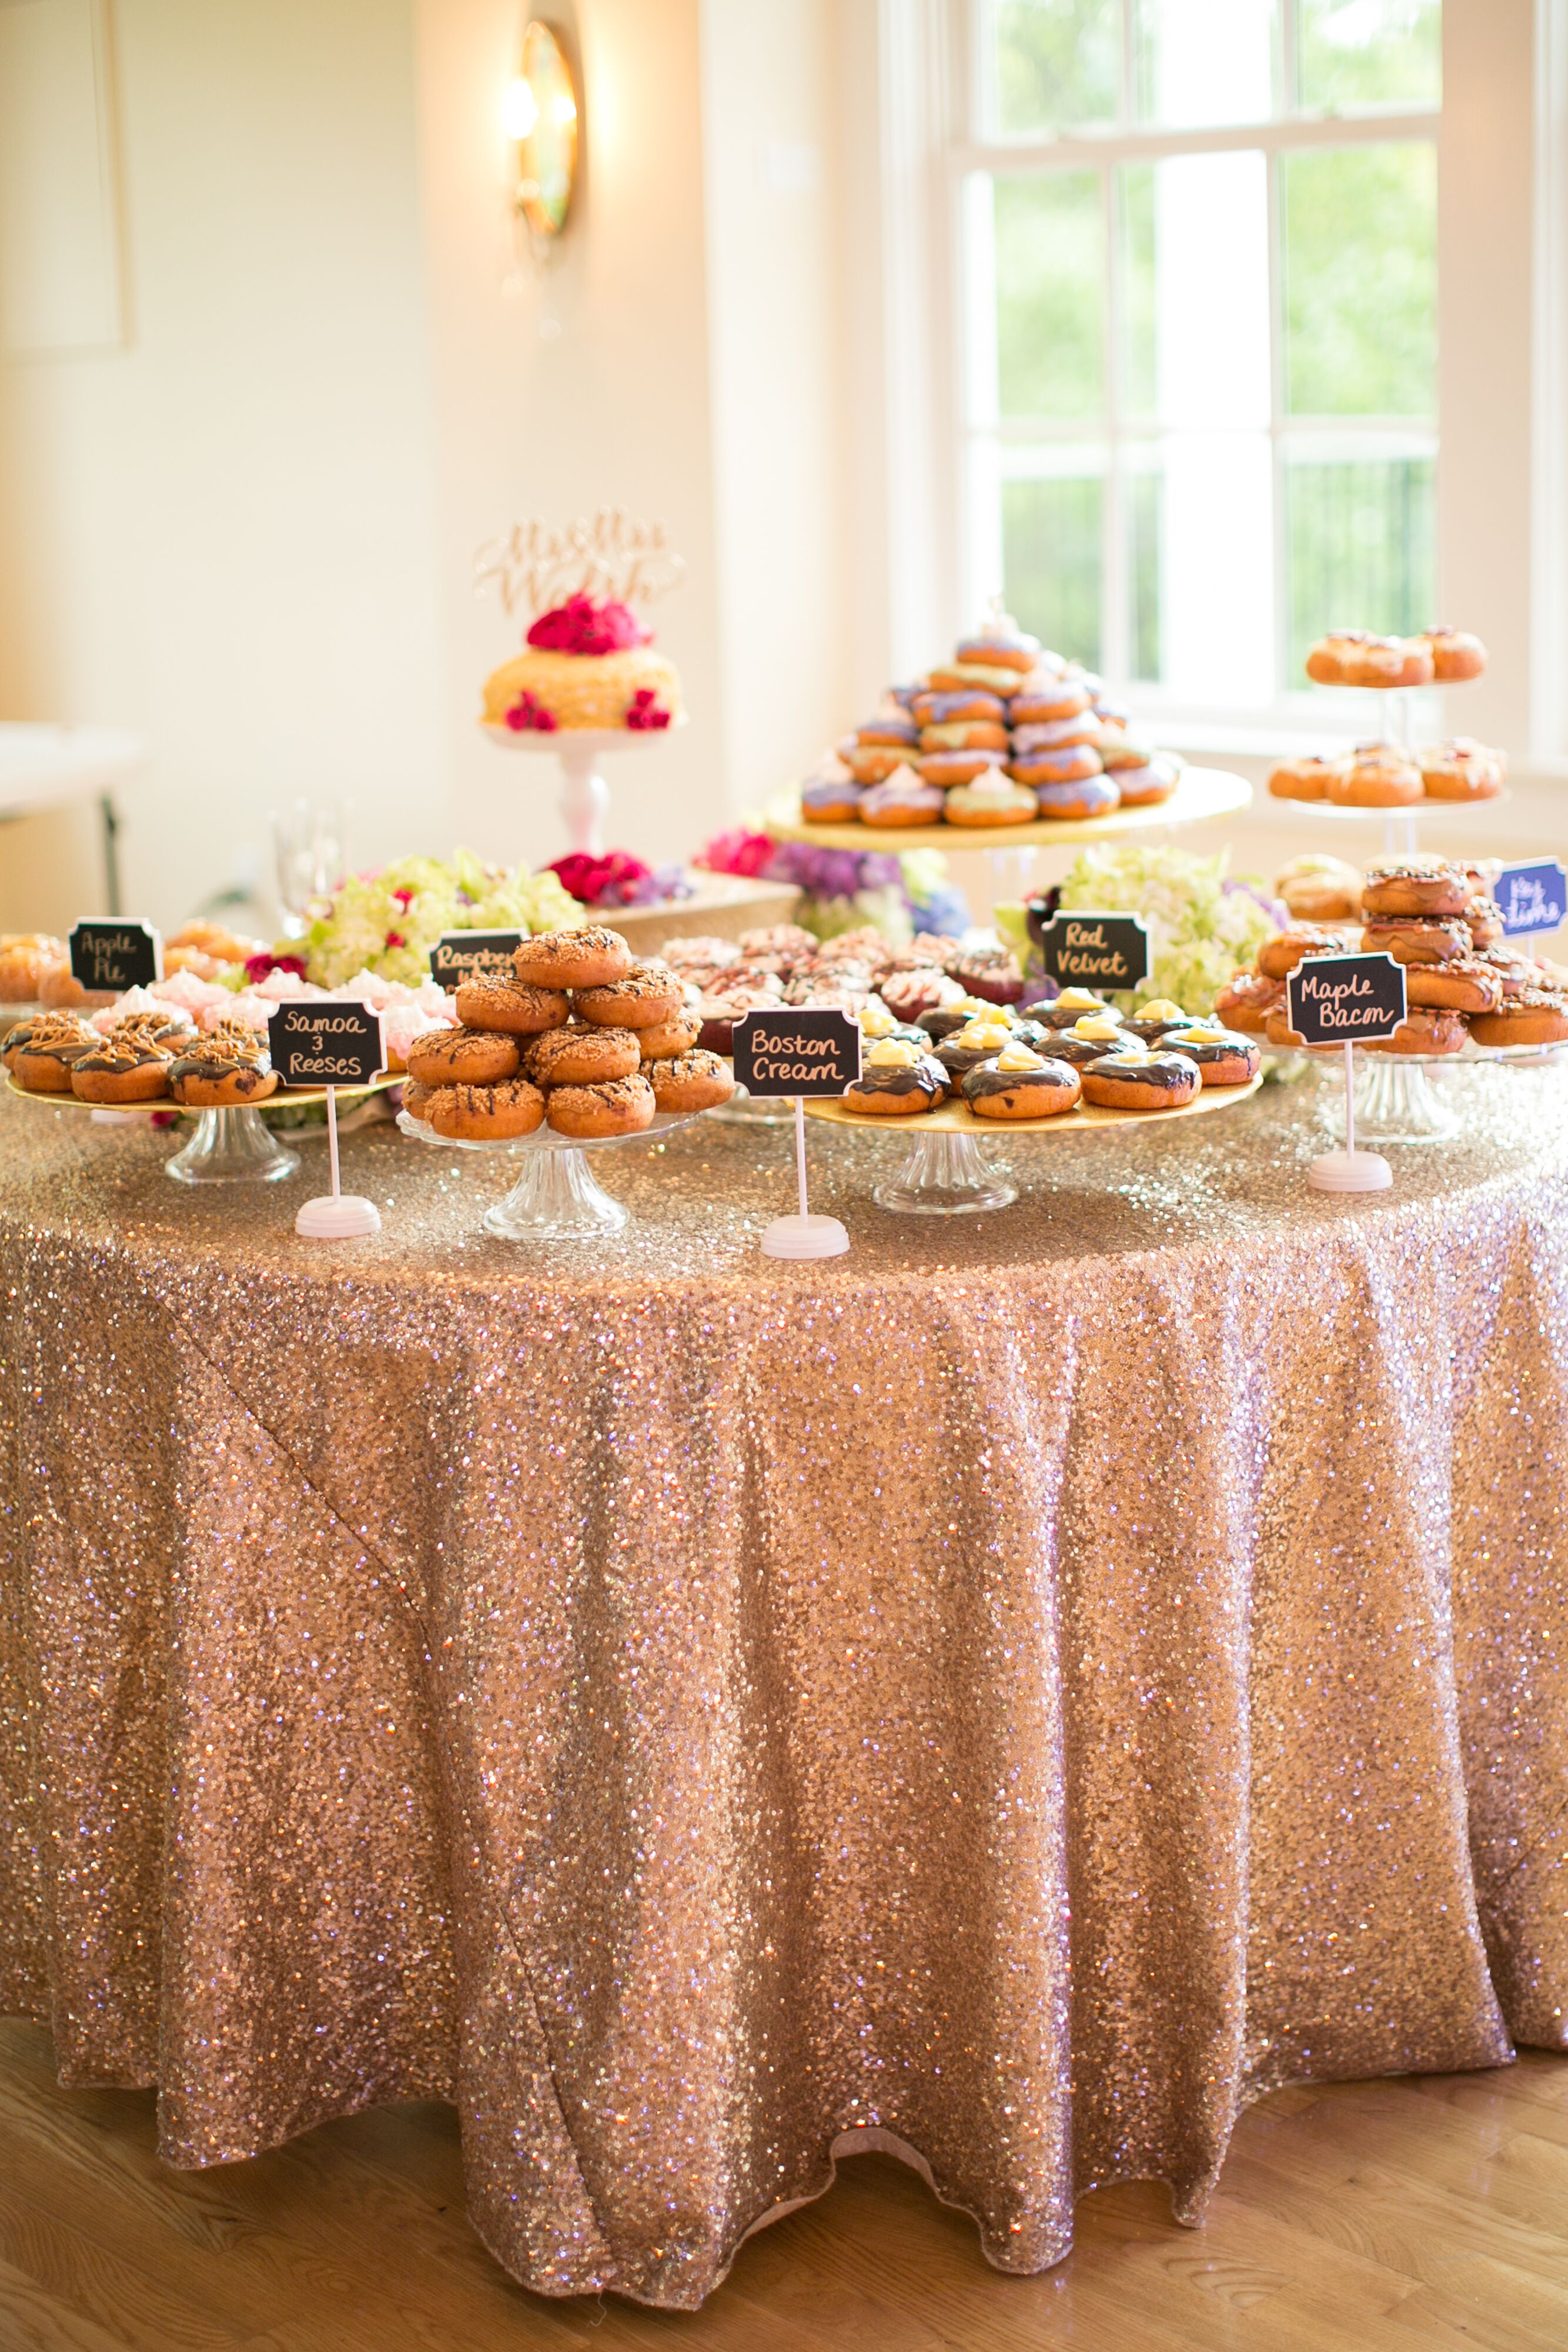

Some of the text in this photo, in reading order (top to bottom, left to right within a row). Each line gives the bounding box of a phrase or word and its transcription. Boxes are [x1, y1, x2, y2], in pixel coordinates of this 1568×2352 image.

[81, 931, 137, 958] Apple
[1066, 922, 1108, 948] Red
[1058, 950, 1128, 976] Velvet
[1301, 974, 1375, 1011] Maple
[285, 1011, 367, 1033] Samoa
[1320, 1001, 1395, 1027] Bacon
[751, 1030, 841, 1055] Boston
[290, 1053, 362, 1075] Reeses
[753, 1057, 845, 1080] Cream
